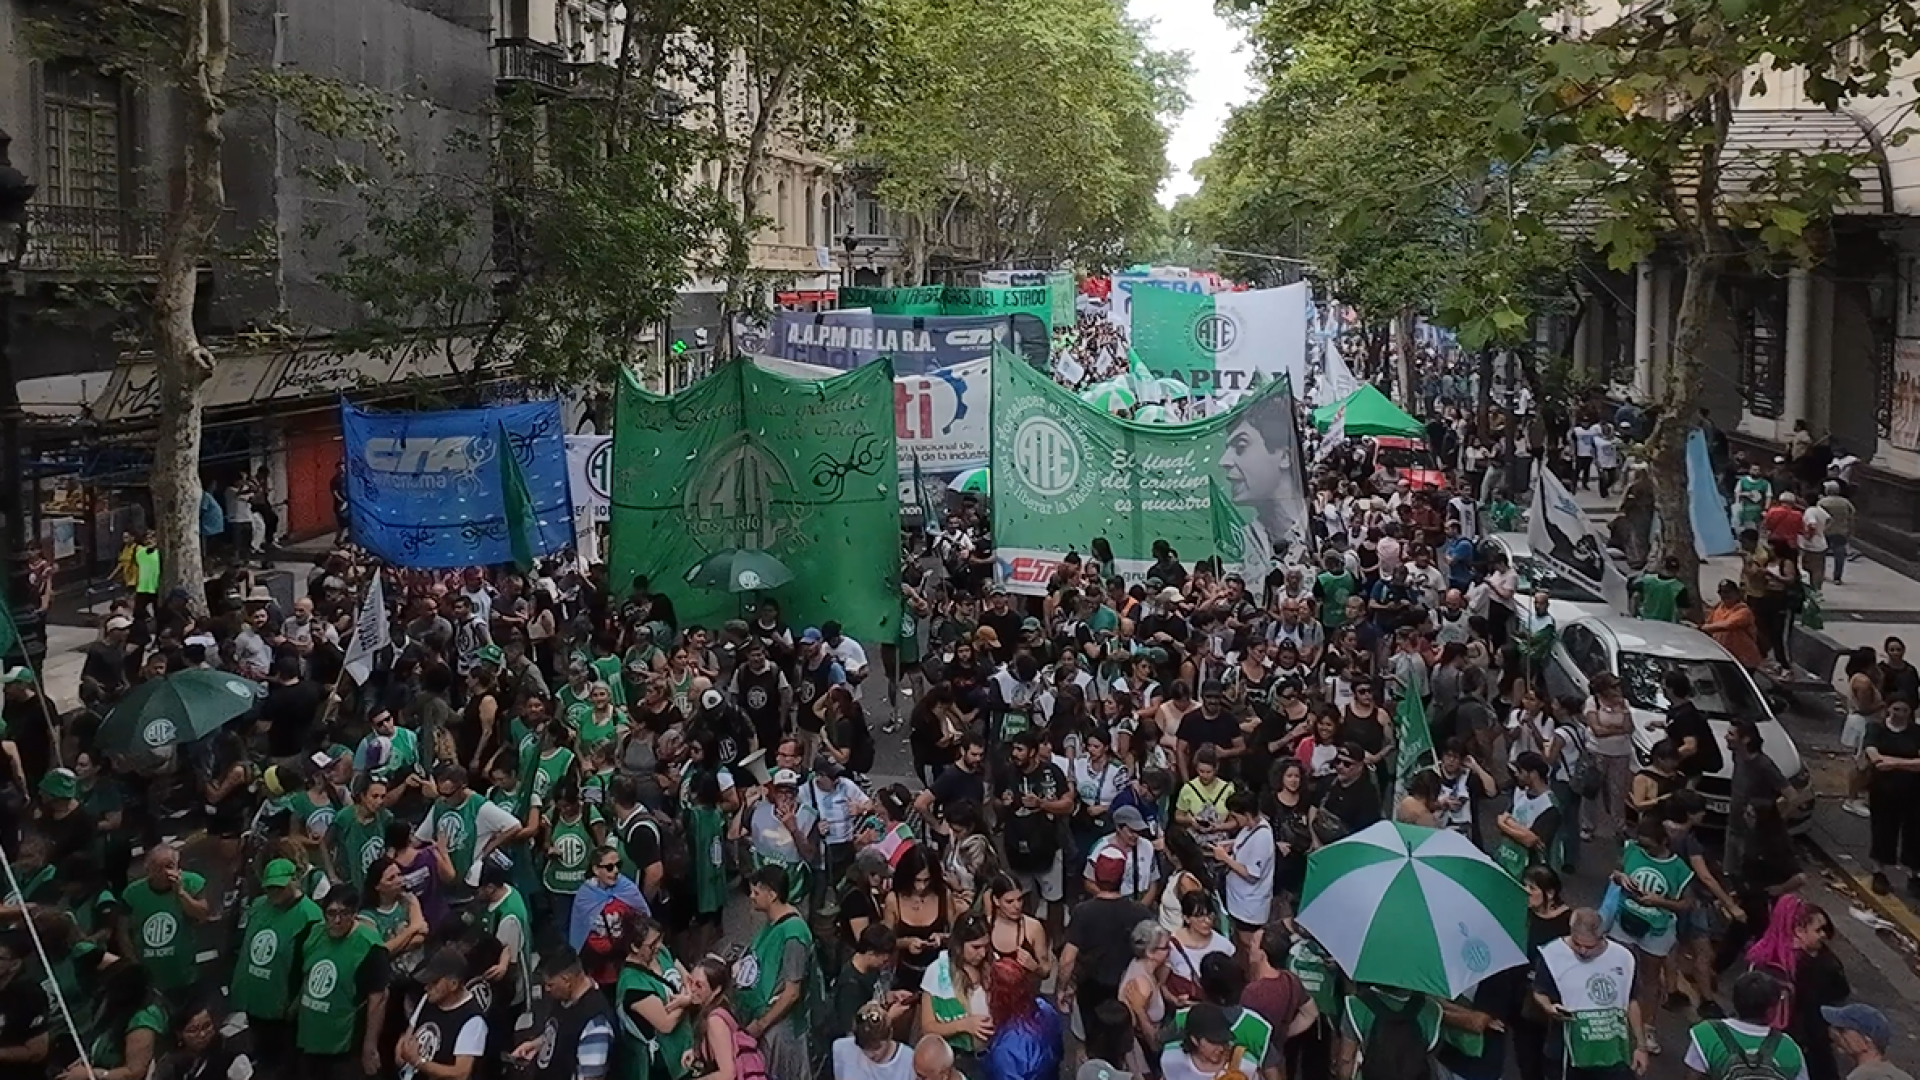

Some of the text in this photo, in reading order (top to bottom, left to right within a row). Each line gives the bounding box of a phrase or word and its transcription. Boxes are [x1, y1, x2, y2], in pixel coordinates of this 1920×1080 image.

[851, 328, 873, 349] DE
[876, 329, 898, 350] LA
[902, 331, 936, 352] R.A.
[1197, 316, 1234, 350] ATE
[1017, 421, 1075, 491] ATE
[1111, 448, 1137, 468] El
[1101, 471, 1133, 489] del
[1114, 496, 1210, 512] es nuestro
[685, 515, 760, 535] ROSARIO
[1011, 557, 1056, 583] CT
[145, 914, 176, 945] ATE
